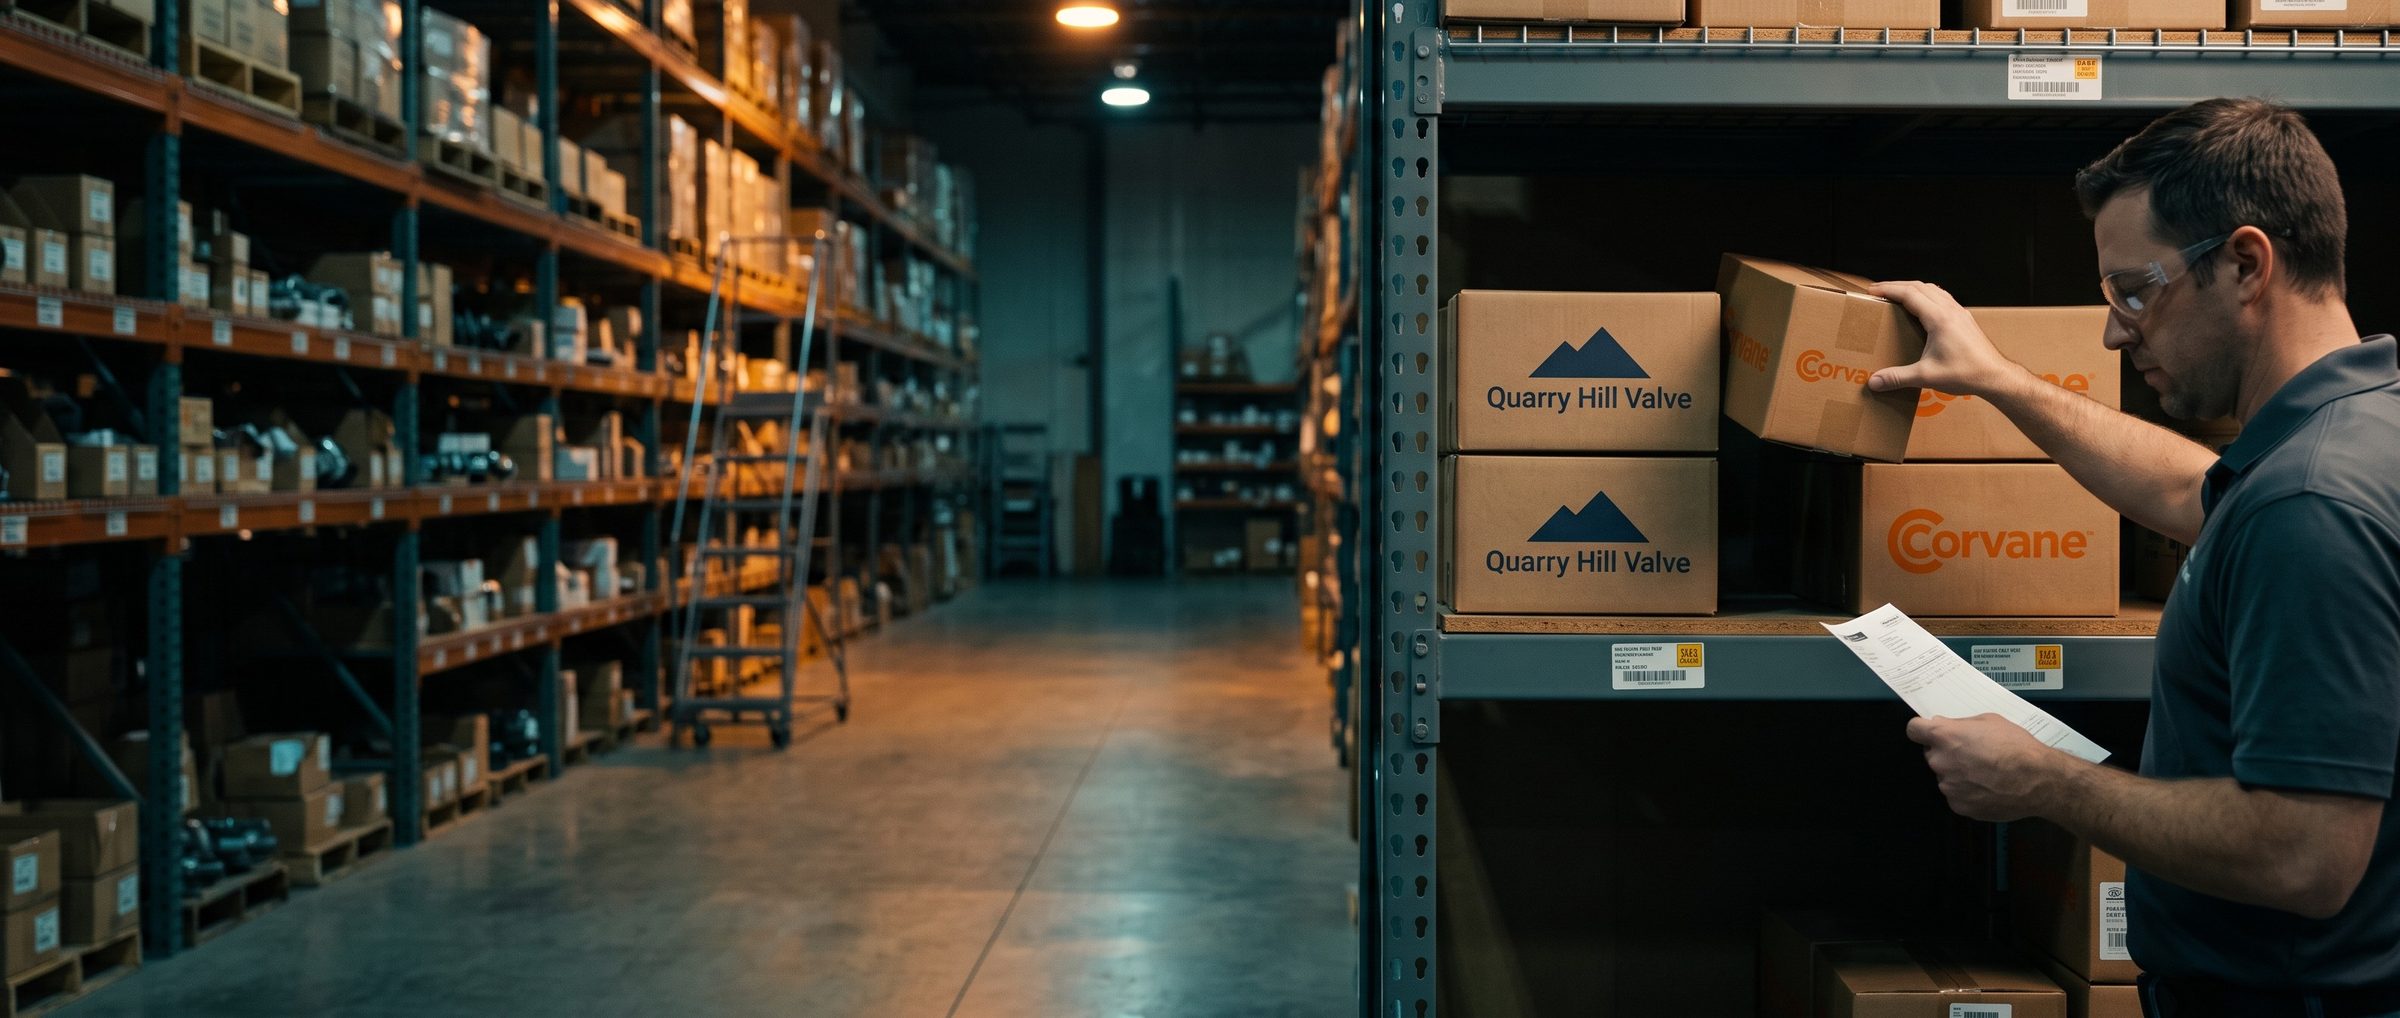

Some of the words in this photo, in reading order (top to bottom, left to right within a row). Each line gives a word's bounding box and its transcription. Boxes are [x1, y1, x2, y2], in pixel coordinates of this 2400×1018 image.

[1488, 386, 1571, 414] Quarry
[1579, 387, 1617, 408] Hill
[1625, 387, 1692, 408] Valve
[1887, 508, 2088, 574] Corvane
[1486, 550, 1570, 578] Quarry
[1578, 551, 1616, 572] Hill
[1624, 551, 1690, 573] Valve
